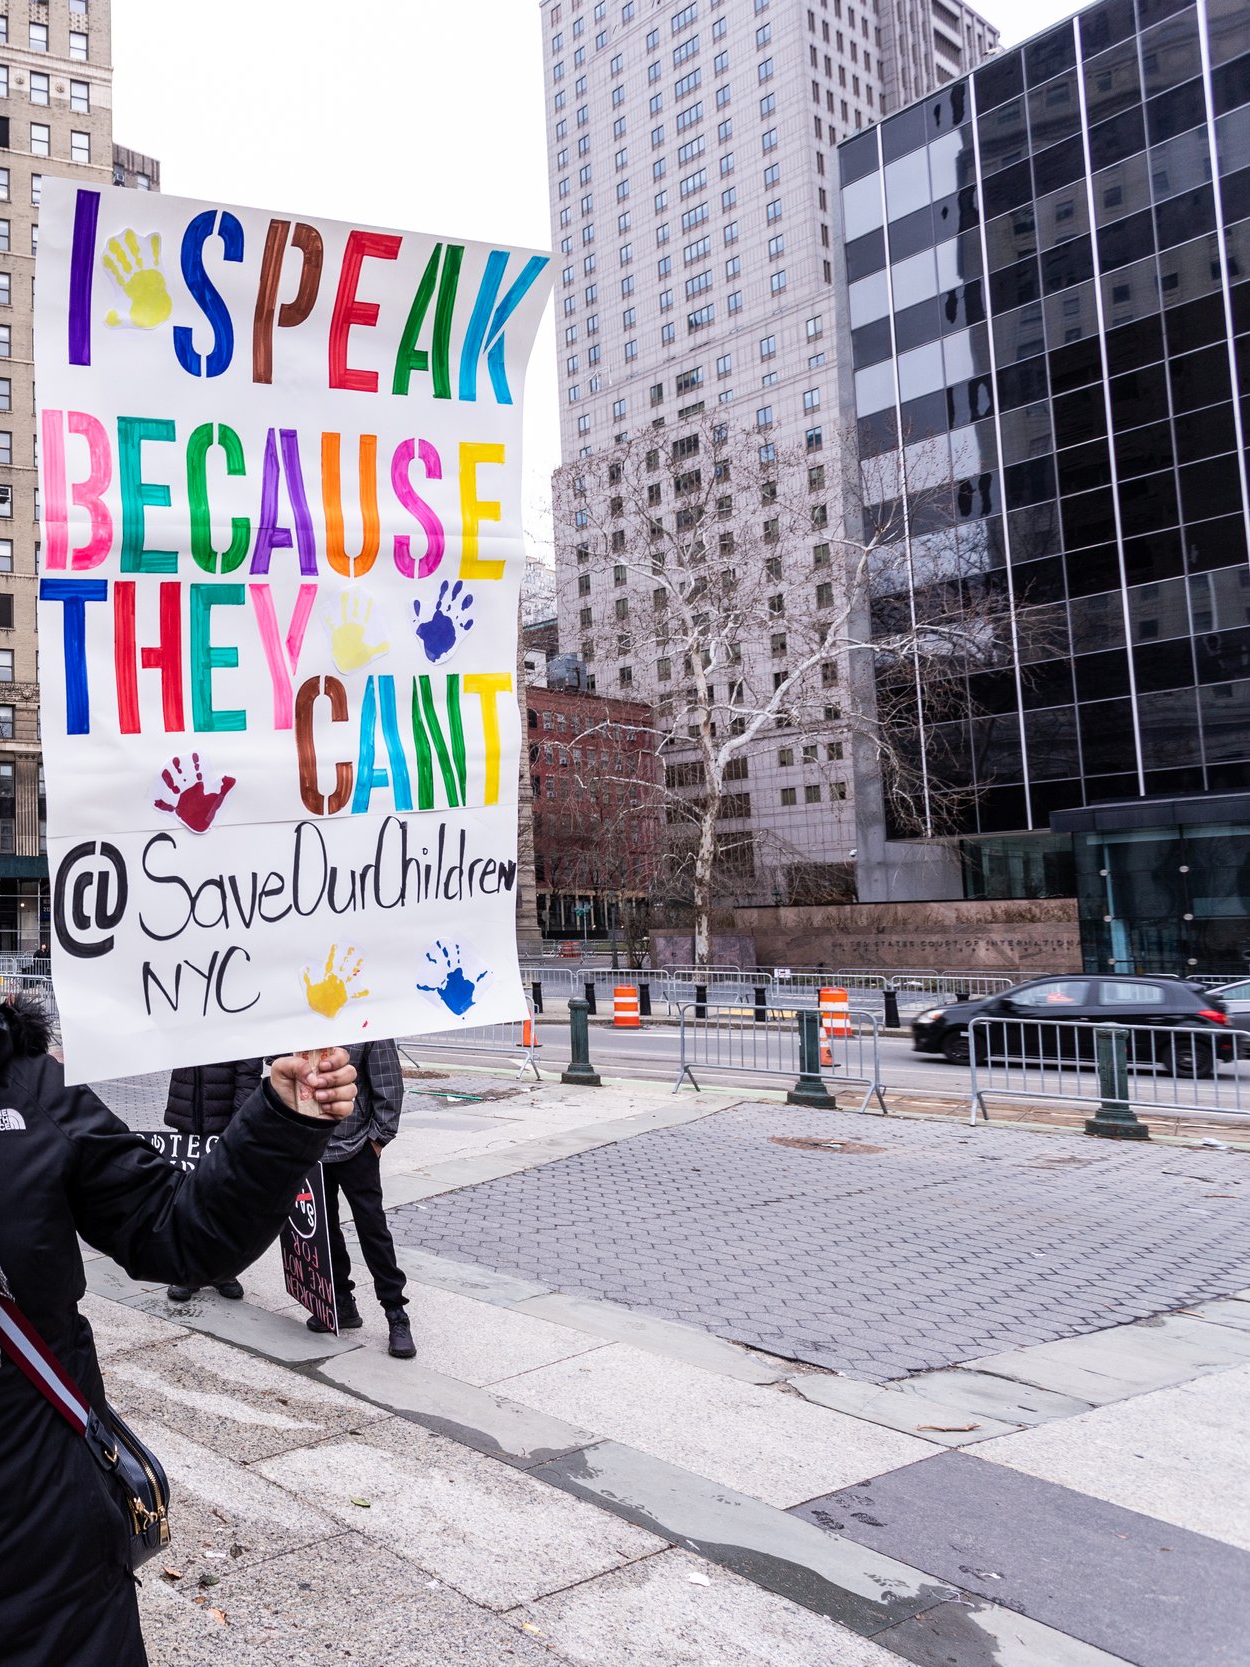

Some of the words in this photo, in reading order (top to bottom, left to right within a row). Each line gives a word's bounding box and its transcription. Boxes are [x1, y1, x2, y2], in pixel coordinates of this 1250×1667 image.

[68, 189, 101, 367] I
[173, 209, 550, 405] SPEAK
[40, 409, 506, 580] BECAUSE
[39, 578, 319, 735] THEY
[295, 672, 513, 816] CANT
[142, 945, 261, 1017] NYC
